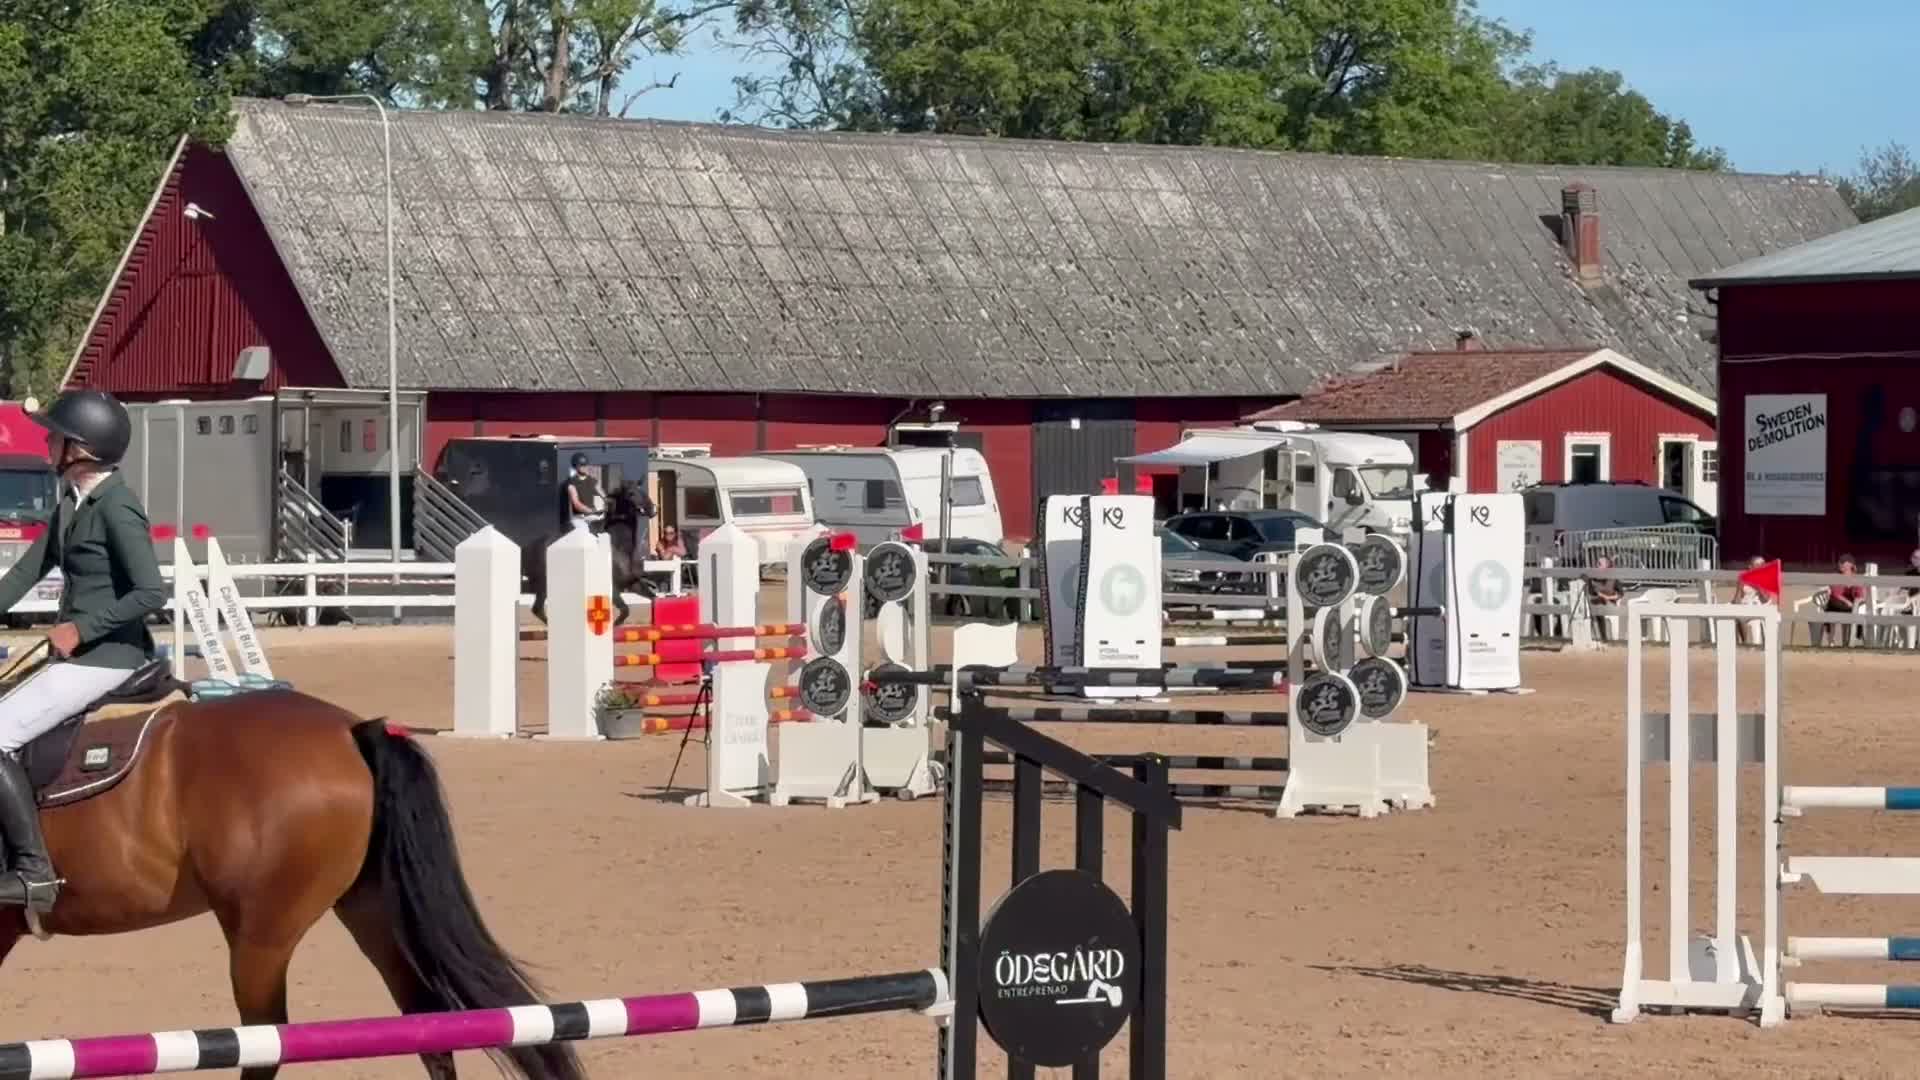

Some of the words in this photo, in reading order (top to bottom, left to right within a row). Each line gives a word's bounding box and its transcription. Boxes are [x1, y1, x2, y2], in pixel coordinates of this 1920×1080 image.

[1747, 412, 1825, 452] DEMOLITION
[1102, 506, 1126, 530] K9
[1470, 505, 1491, 527] K9
[213, 657, 227, 672] AB
[247, 651, 260, 666] AB
[995, 945, 1124, 986] ÖDEGÅRD
[997, 984, 1068, 999] ENTREPRENAD
